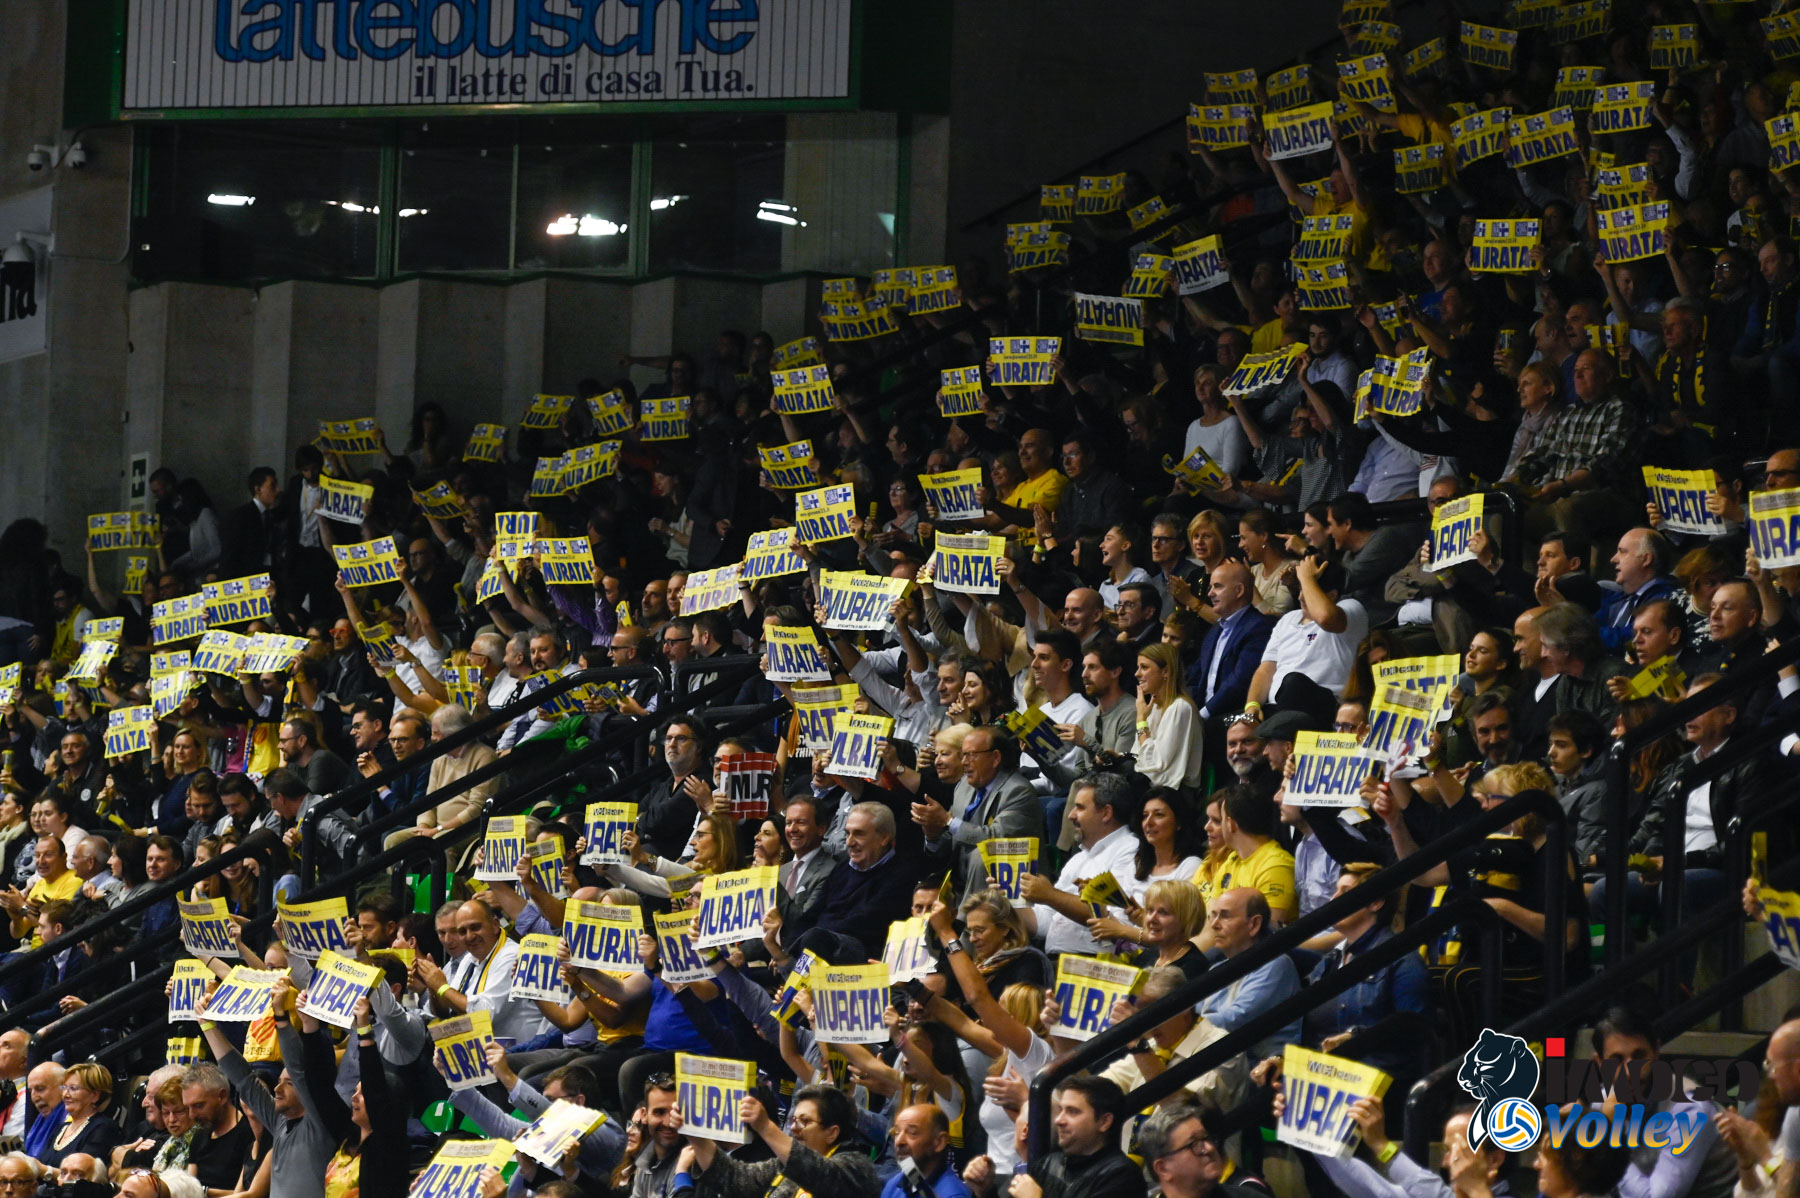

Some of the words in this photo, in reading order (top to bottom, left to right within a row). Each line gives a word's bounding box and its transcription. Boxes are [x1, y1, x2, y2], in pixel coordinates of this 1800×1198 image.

[414, 66, 435, 97] il
[448, 66, 527, 97] latte
[539, 64, 573, 96] di
[586, 68, 662, 95] casa
[675, 60, 755, 93] Tua.
[778, 389, 834, 412] MURATA!
